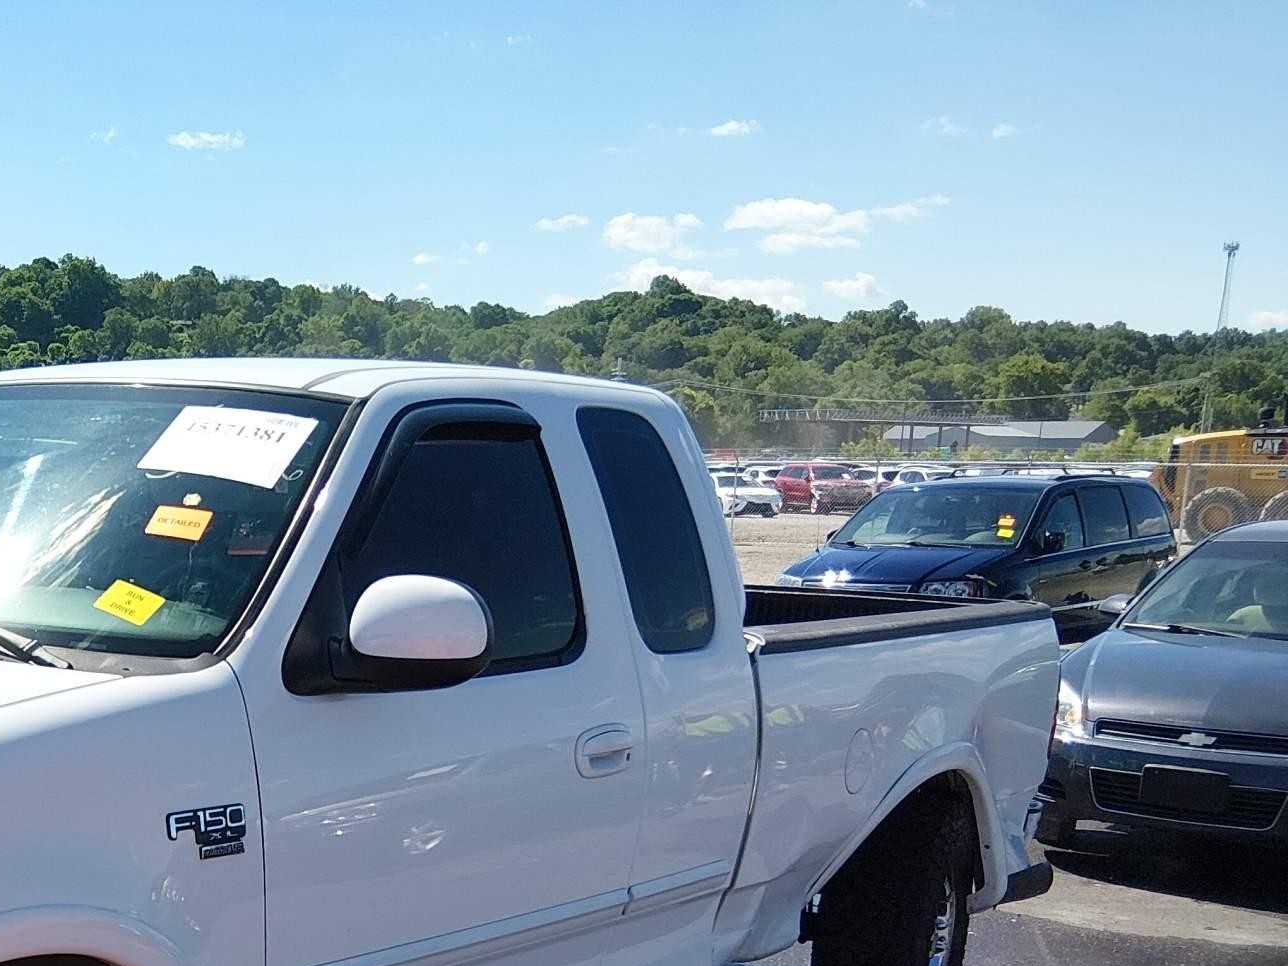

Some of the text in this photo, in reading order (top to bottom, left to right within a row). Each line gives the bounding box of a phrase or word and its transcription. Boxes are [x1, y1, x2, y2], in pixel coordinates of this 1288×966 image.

[1252, 439, 1282, 455] CAT
[157, 517, 201, 528] DETAILED
[126, 591, 145, 601] RUN
[109, 602, 136, 617] DRIVE
